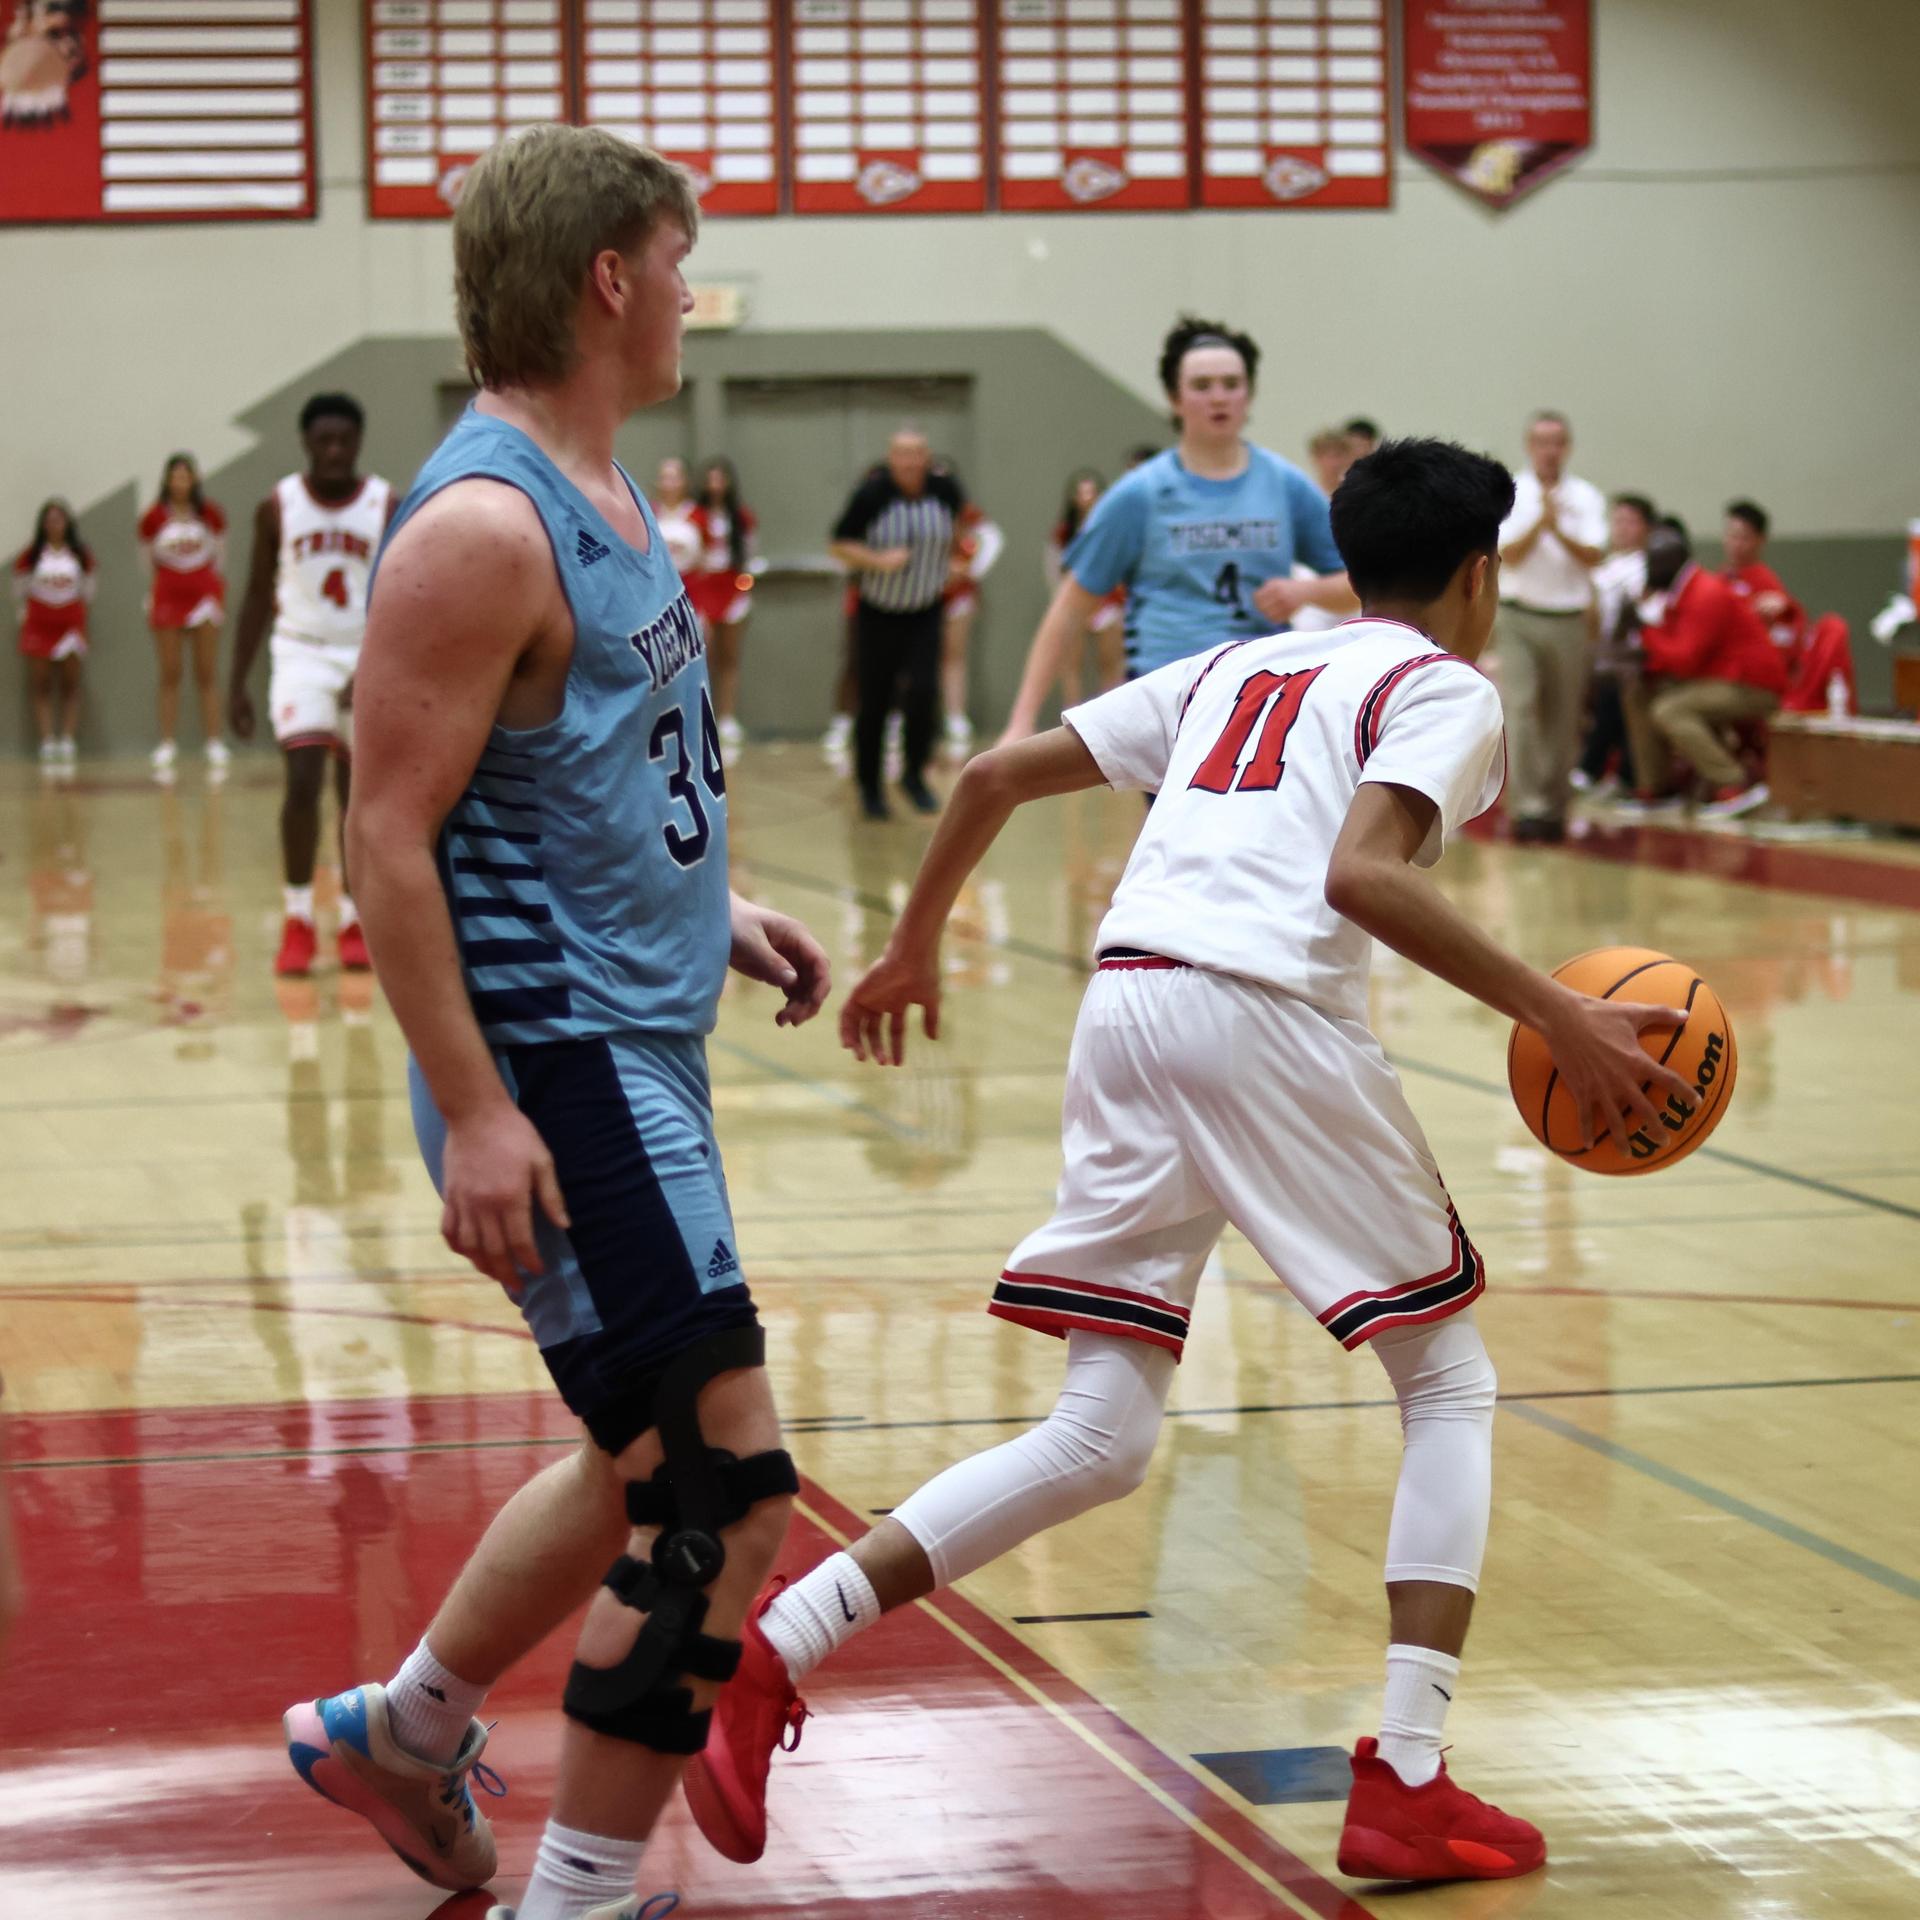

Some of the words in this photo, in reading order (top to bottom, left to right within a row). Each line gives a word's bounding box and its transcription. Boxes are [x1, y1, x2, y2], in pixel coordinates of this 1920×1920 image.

[320, 567, 350, 609] 4
[628, 588, 706, 694] YOSEMI
[1214, 560, 1250, 621] 4
[647, 683, 728, 871] 34
[1186, 662, 1330, 795] 11
